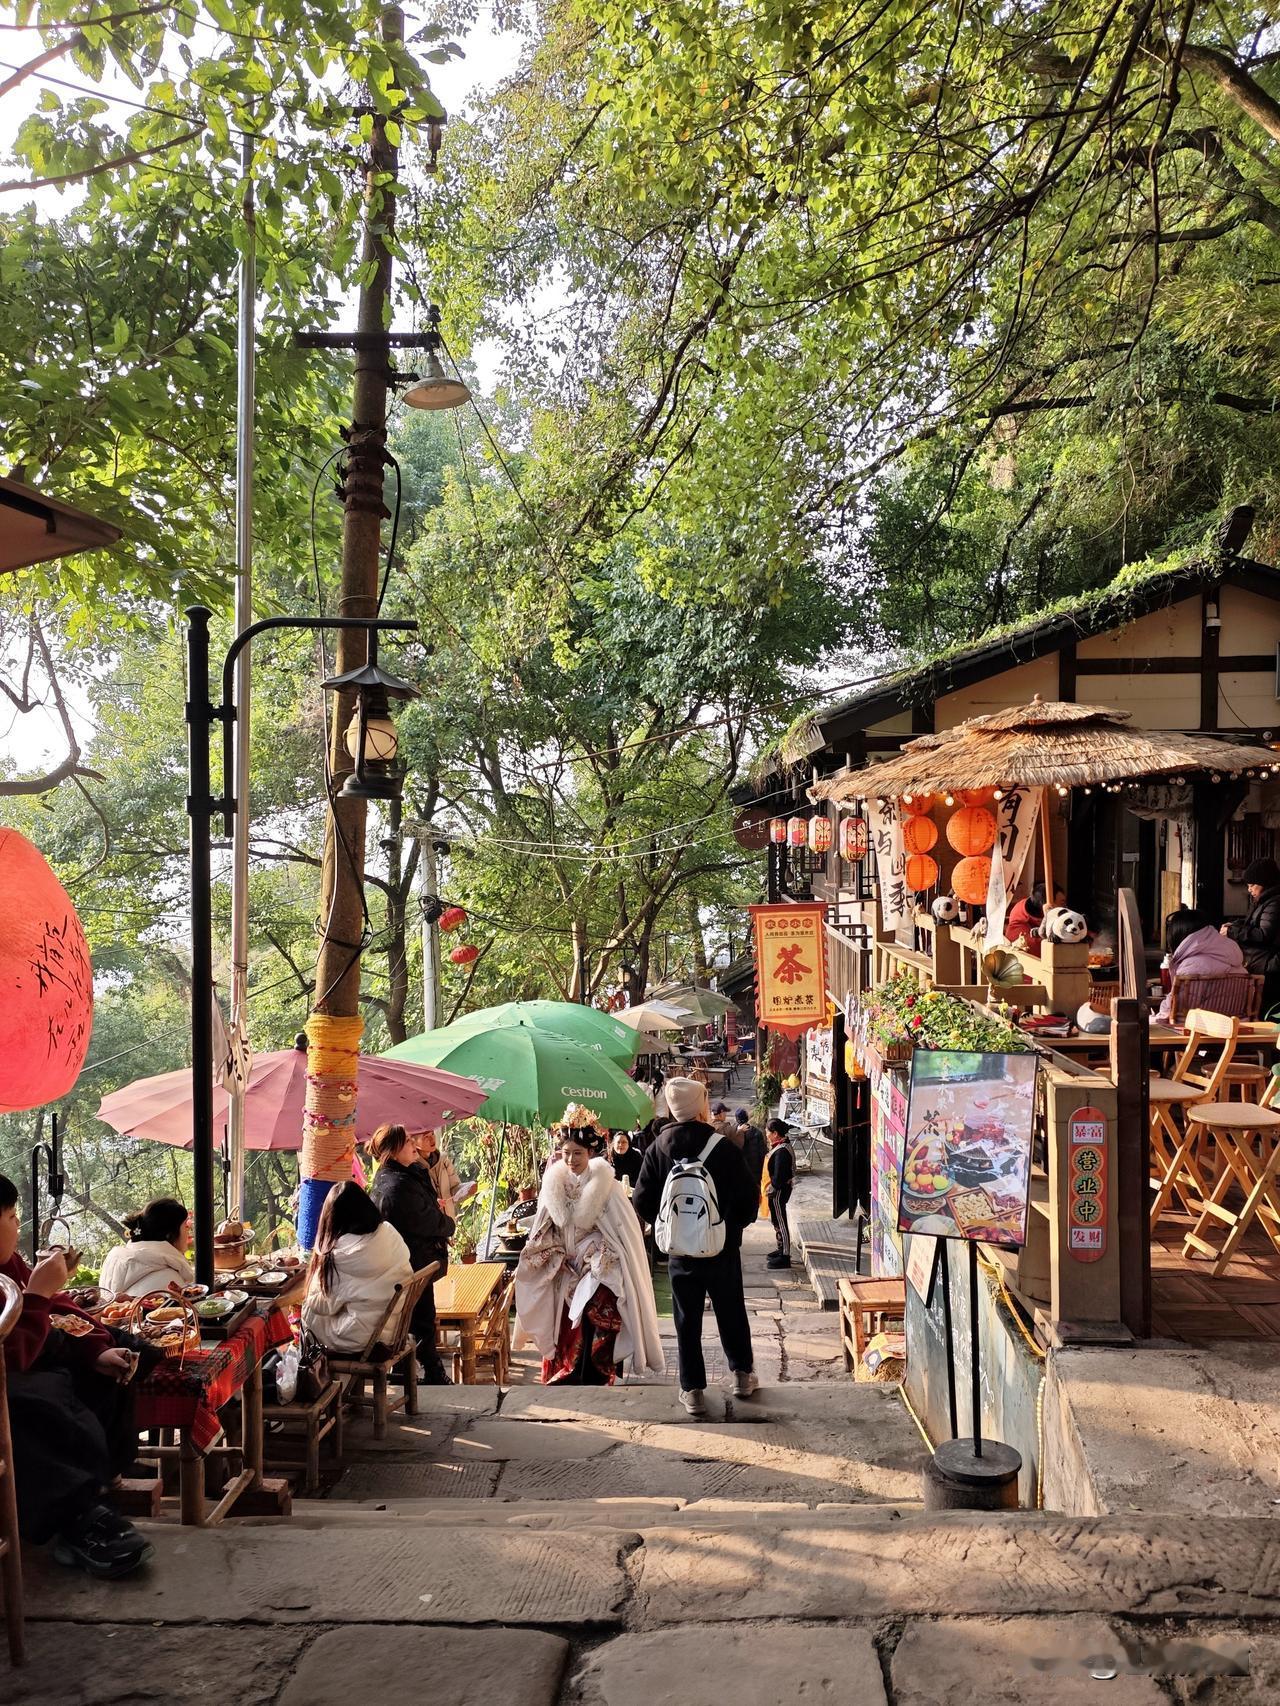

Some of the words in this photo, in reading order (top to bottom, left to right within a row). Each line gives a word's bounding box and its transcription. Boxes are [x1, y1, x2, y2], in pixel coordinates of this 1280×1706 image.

[773, 943, 813, 985] 茶
[1077, 1151, 1098, 1221] 营业中
[1073, 1230, 1101, 1243] 发财
